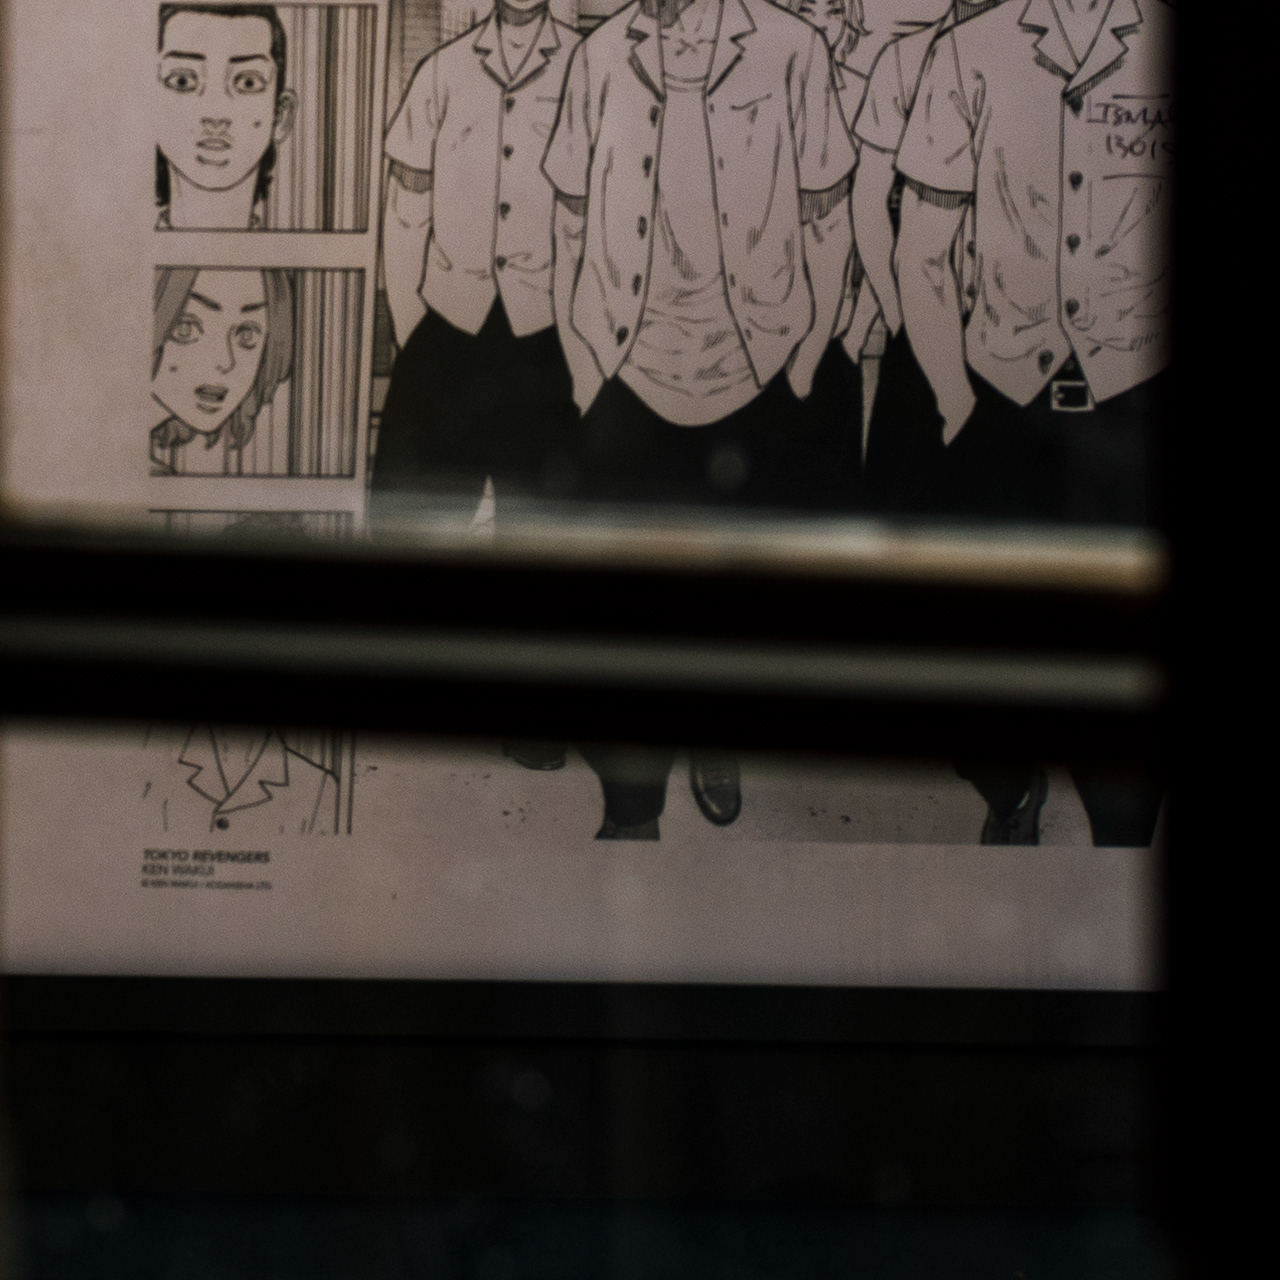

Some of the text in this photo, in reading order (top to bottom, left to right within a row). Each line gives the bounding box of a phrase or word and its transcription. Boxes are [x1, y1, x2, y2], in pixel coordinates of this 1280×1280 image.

[143, 849, 271, 864] TOKYO REVENGERS
[142, 864, 169, 876] KEN
